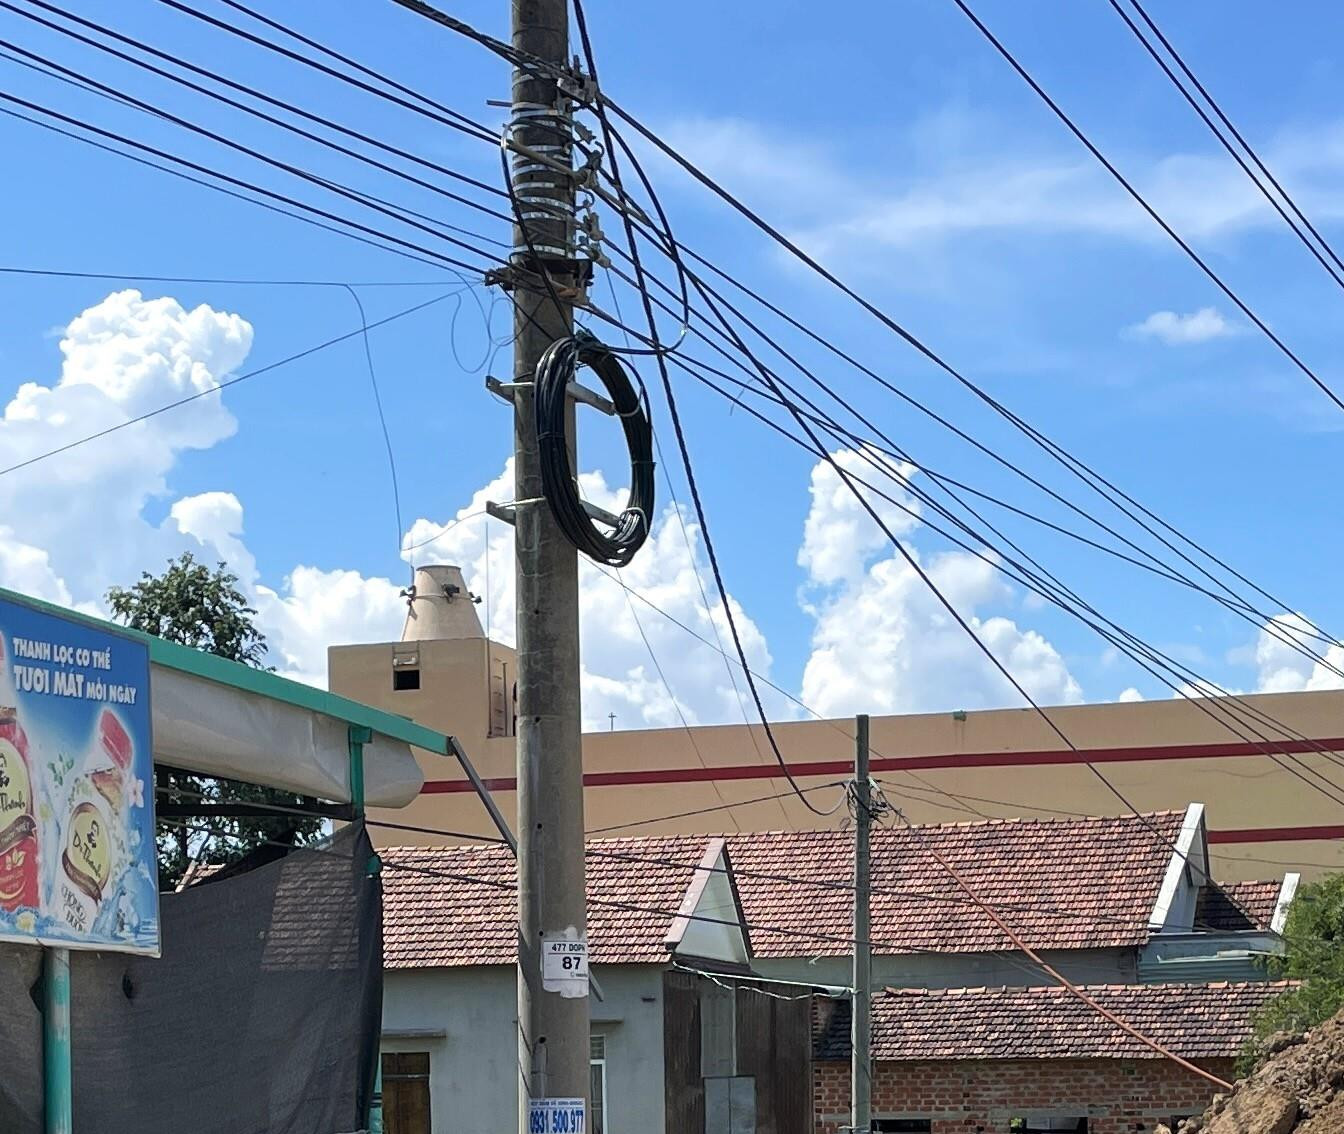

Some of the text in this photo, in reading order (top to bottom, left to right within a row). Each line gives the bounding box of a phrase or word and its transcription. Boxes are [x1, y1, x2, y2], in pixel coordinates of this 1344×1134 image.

[13, 637, 50, 661] THANH
[53, 645, 73, 667] LỌC
[53, 668, 84, 698] MÁT
[552, 943, 566, 951] 477
[562, 956, 581, 970] 87
